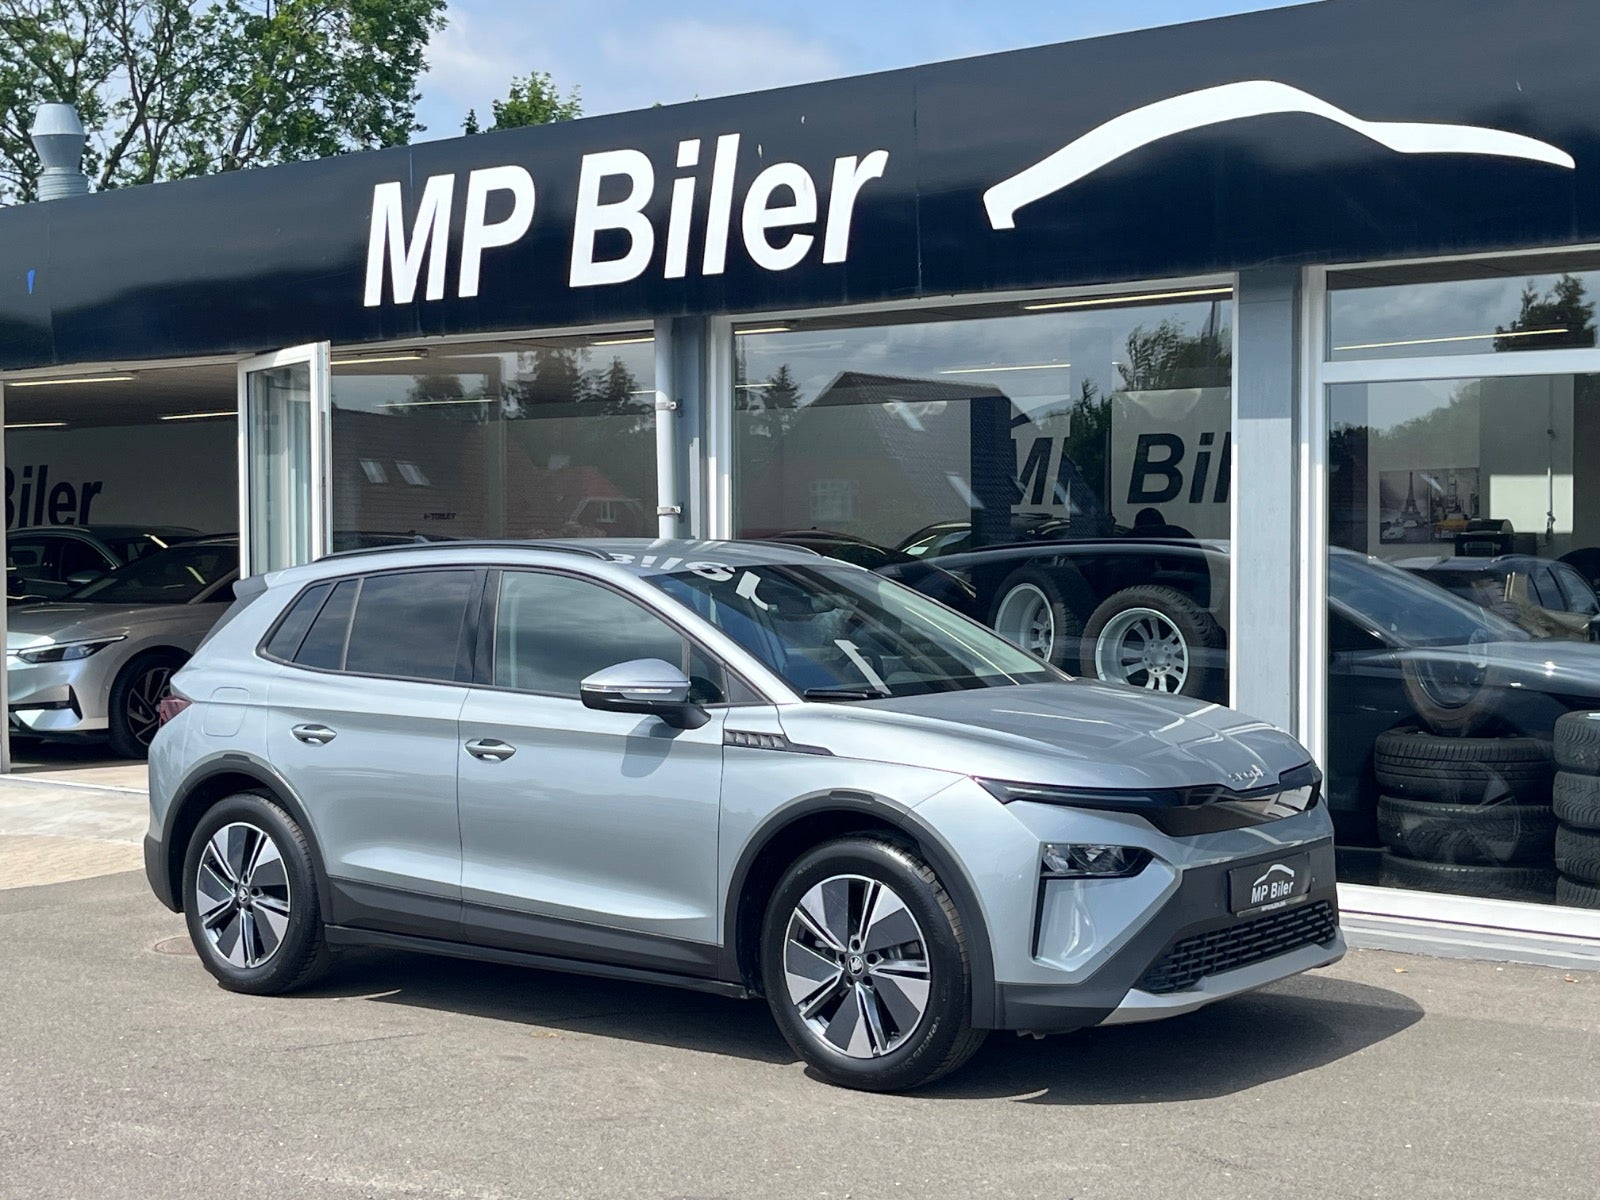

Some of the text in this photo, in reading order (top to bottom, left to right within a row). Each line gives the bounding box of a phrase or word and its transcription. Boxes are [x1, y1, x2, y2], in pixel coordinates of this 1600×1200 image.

[364, 133, 889, 307] MP Biler
[1251, 880, 1294, 904] MP Biler
